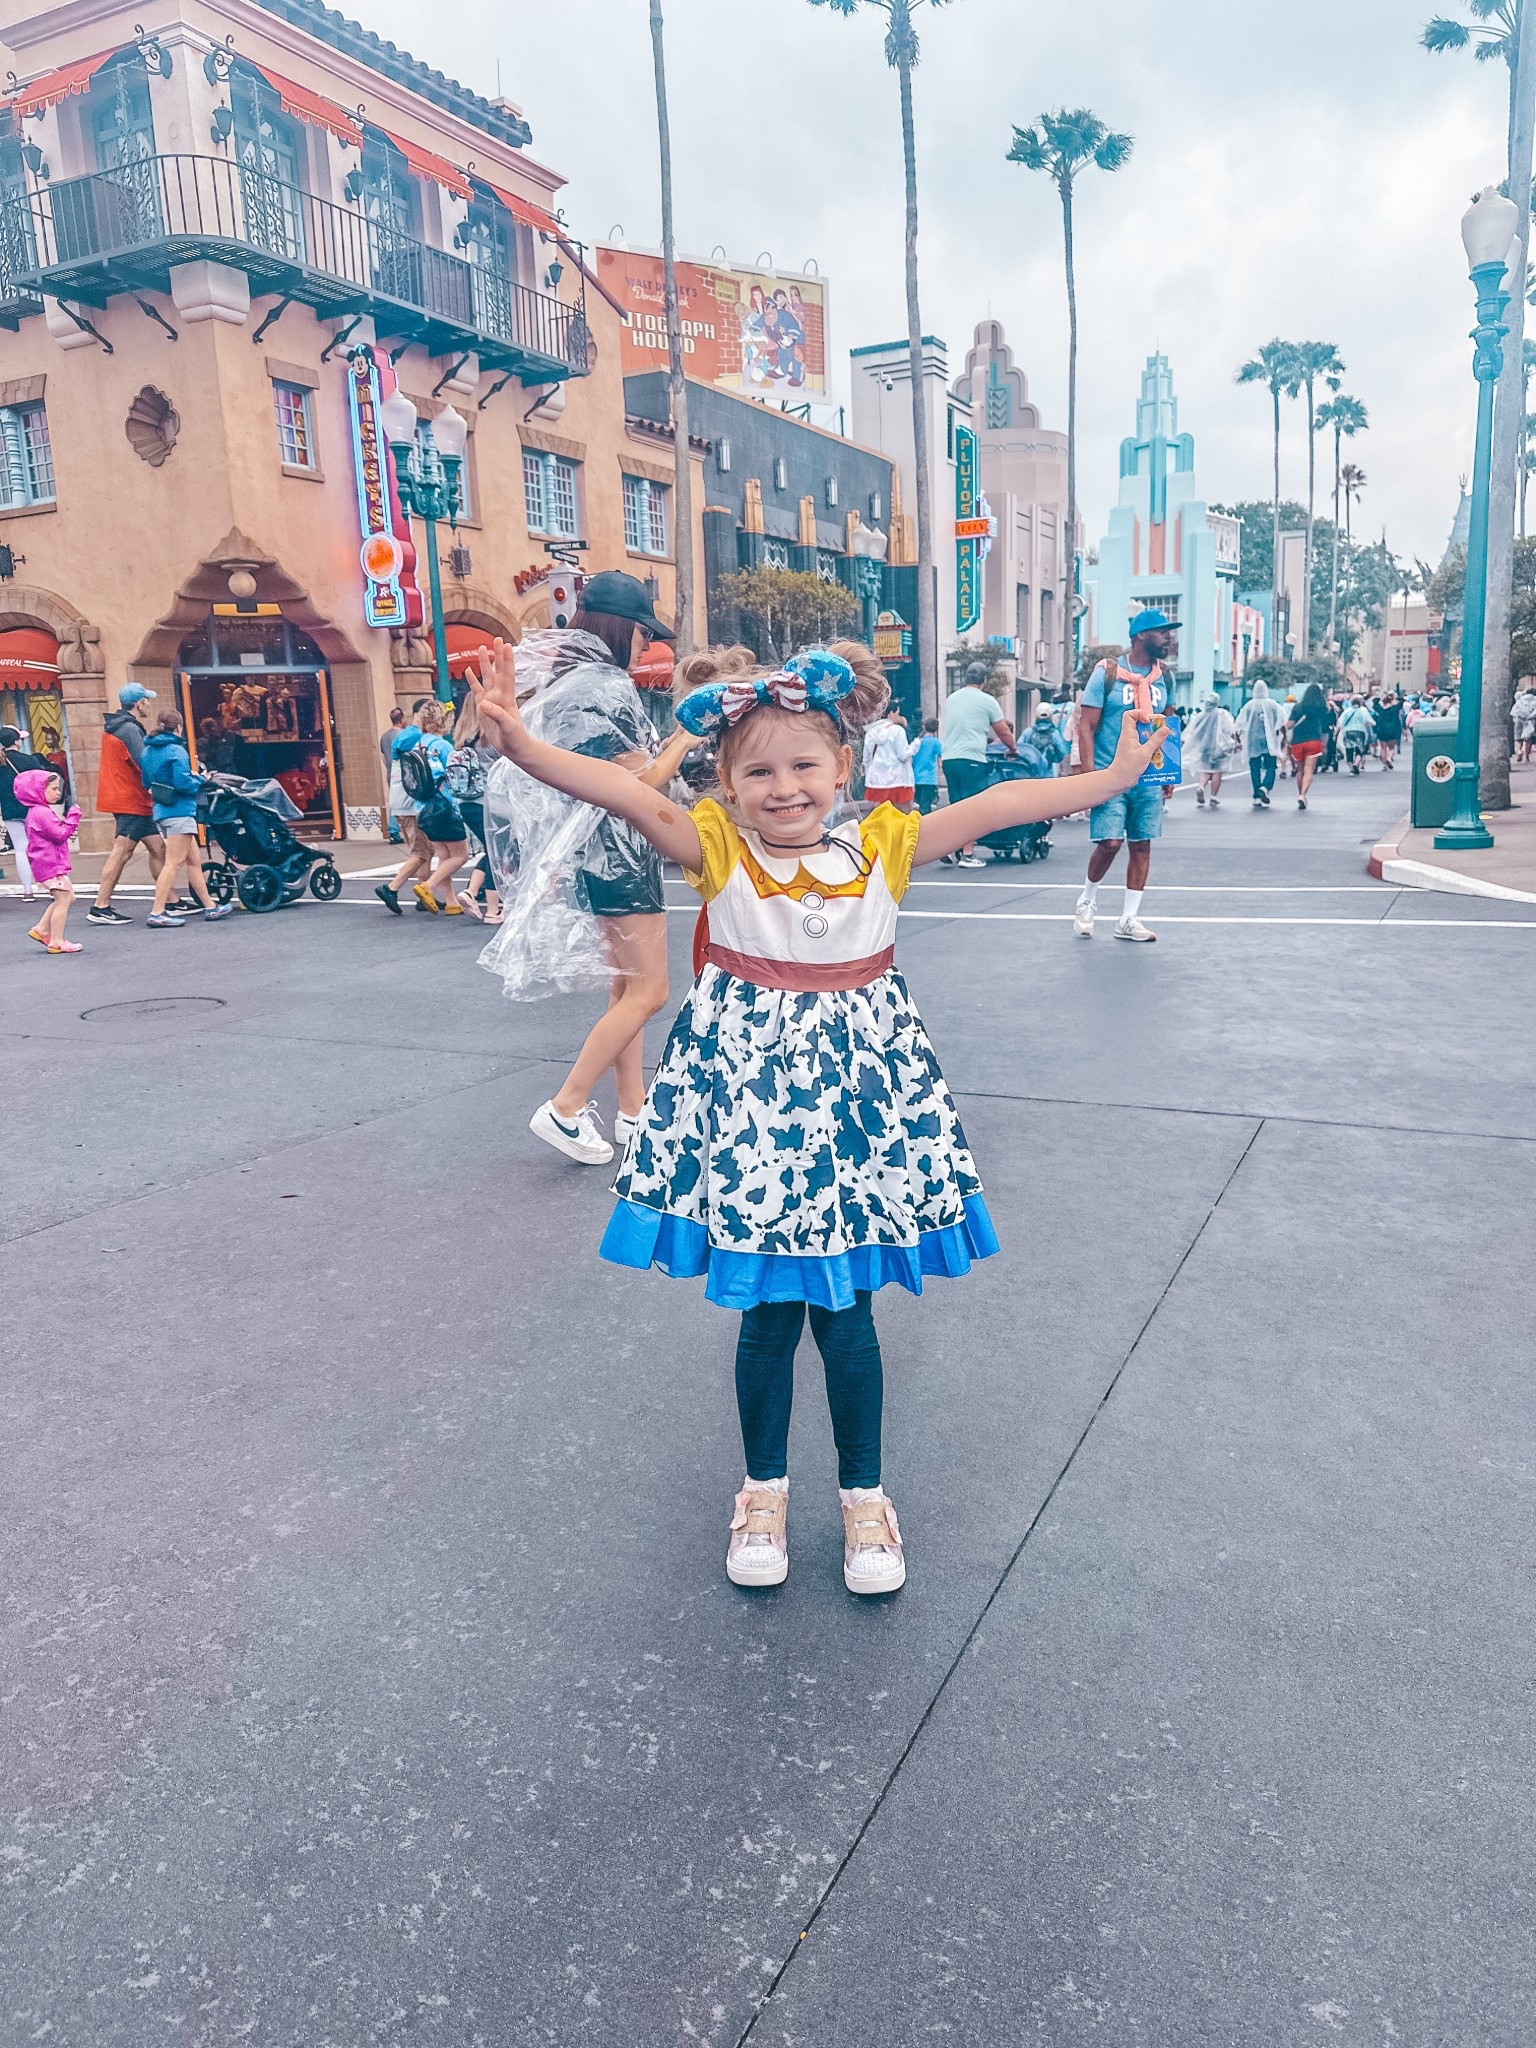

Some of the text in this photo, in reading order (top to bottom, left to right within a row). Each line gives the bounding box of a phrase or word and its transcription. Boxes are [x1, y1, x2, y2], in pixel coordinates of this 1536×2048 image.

[625, 276, 698, 298] WALT DIEY'S
[621, 311, 715, 340] UTOGAPH
[632, 330, 696, 354] HOUD
[960, 438, 973, 515] PLUTO'S
[959, 522, 985, 534] TOY
[959, 544, 971, 619] PALACE
[1122, 683, 1162, 708] GP
